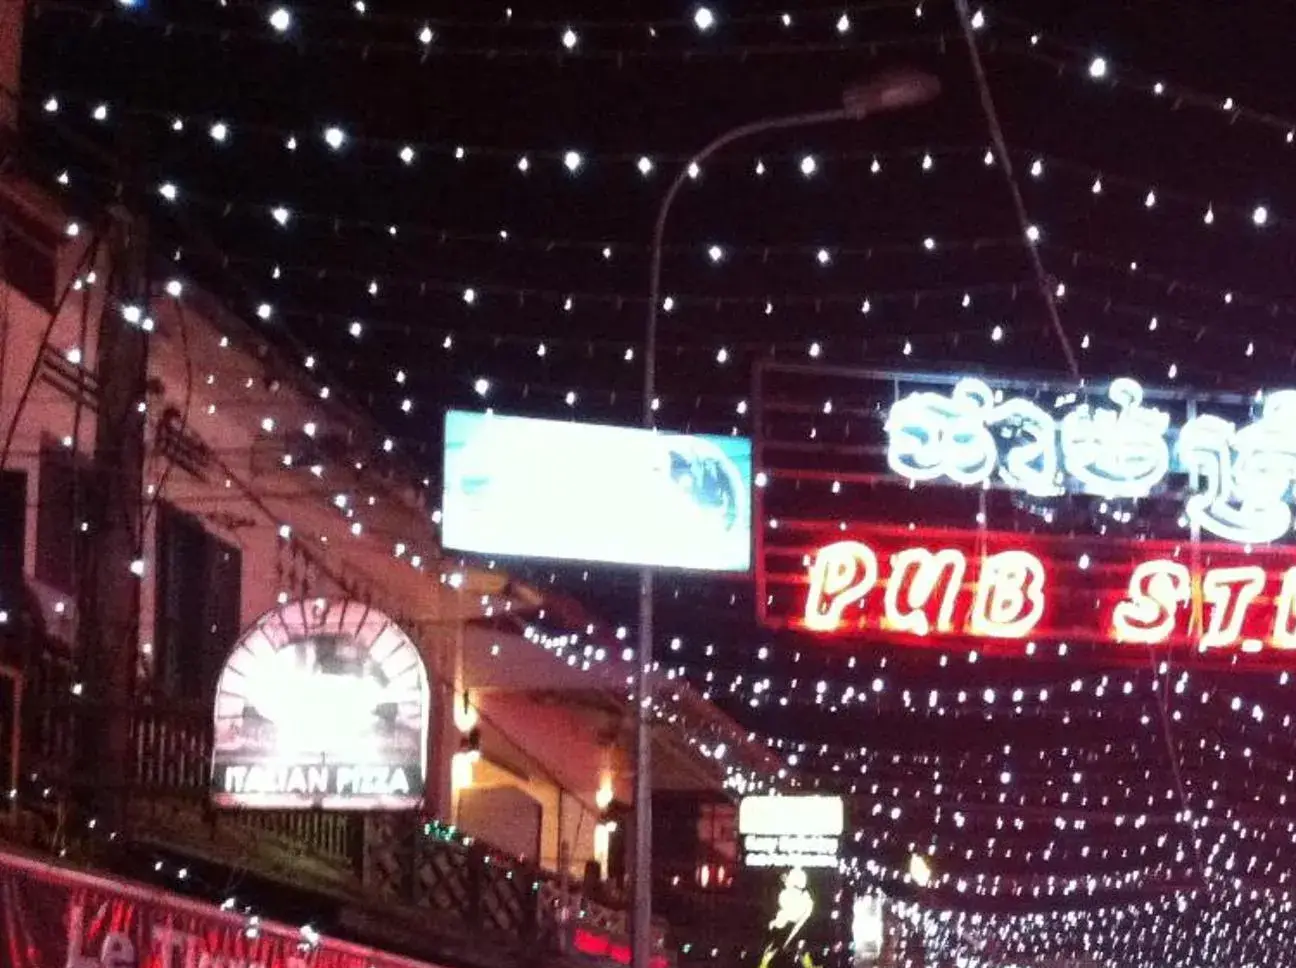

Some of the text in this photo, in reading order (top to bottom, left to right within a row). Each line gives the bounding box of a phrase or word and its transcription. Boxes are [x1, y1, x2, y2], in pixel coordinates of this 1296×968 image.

[803, 541, 1045, 640] PUB
[224, 766, 410, 794] ITALIAN PIZZA
